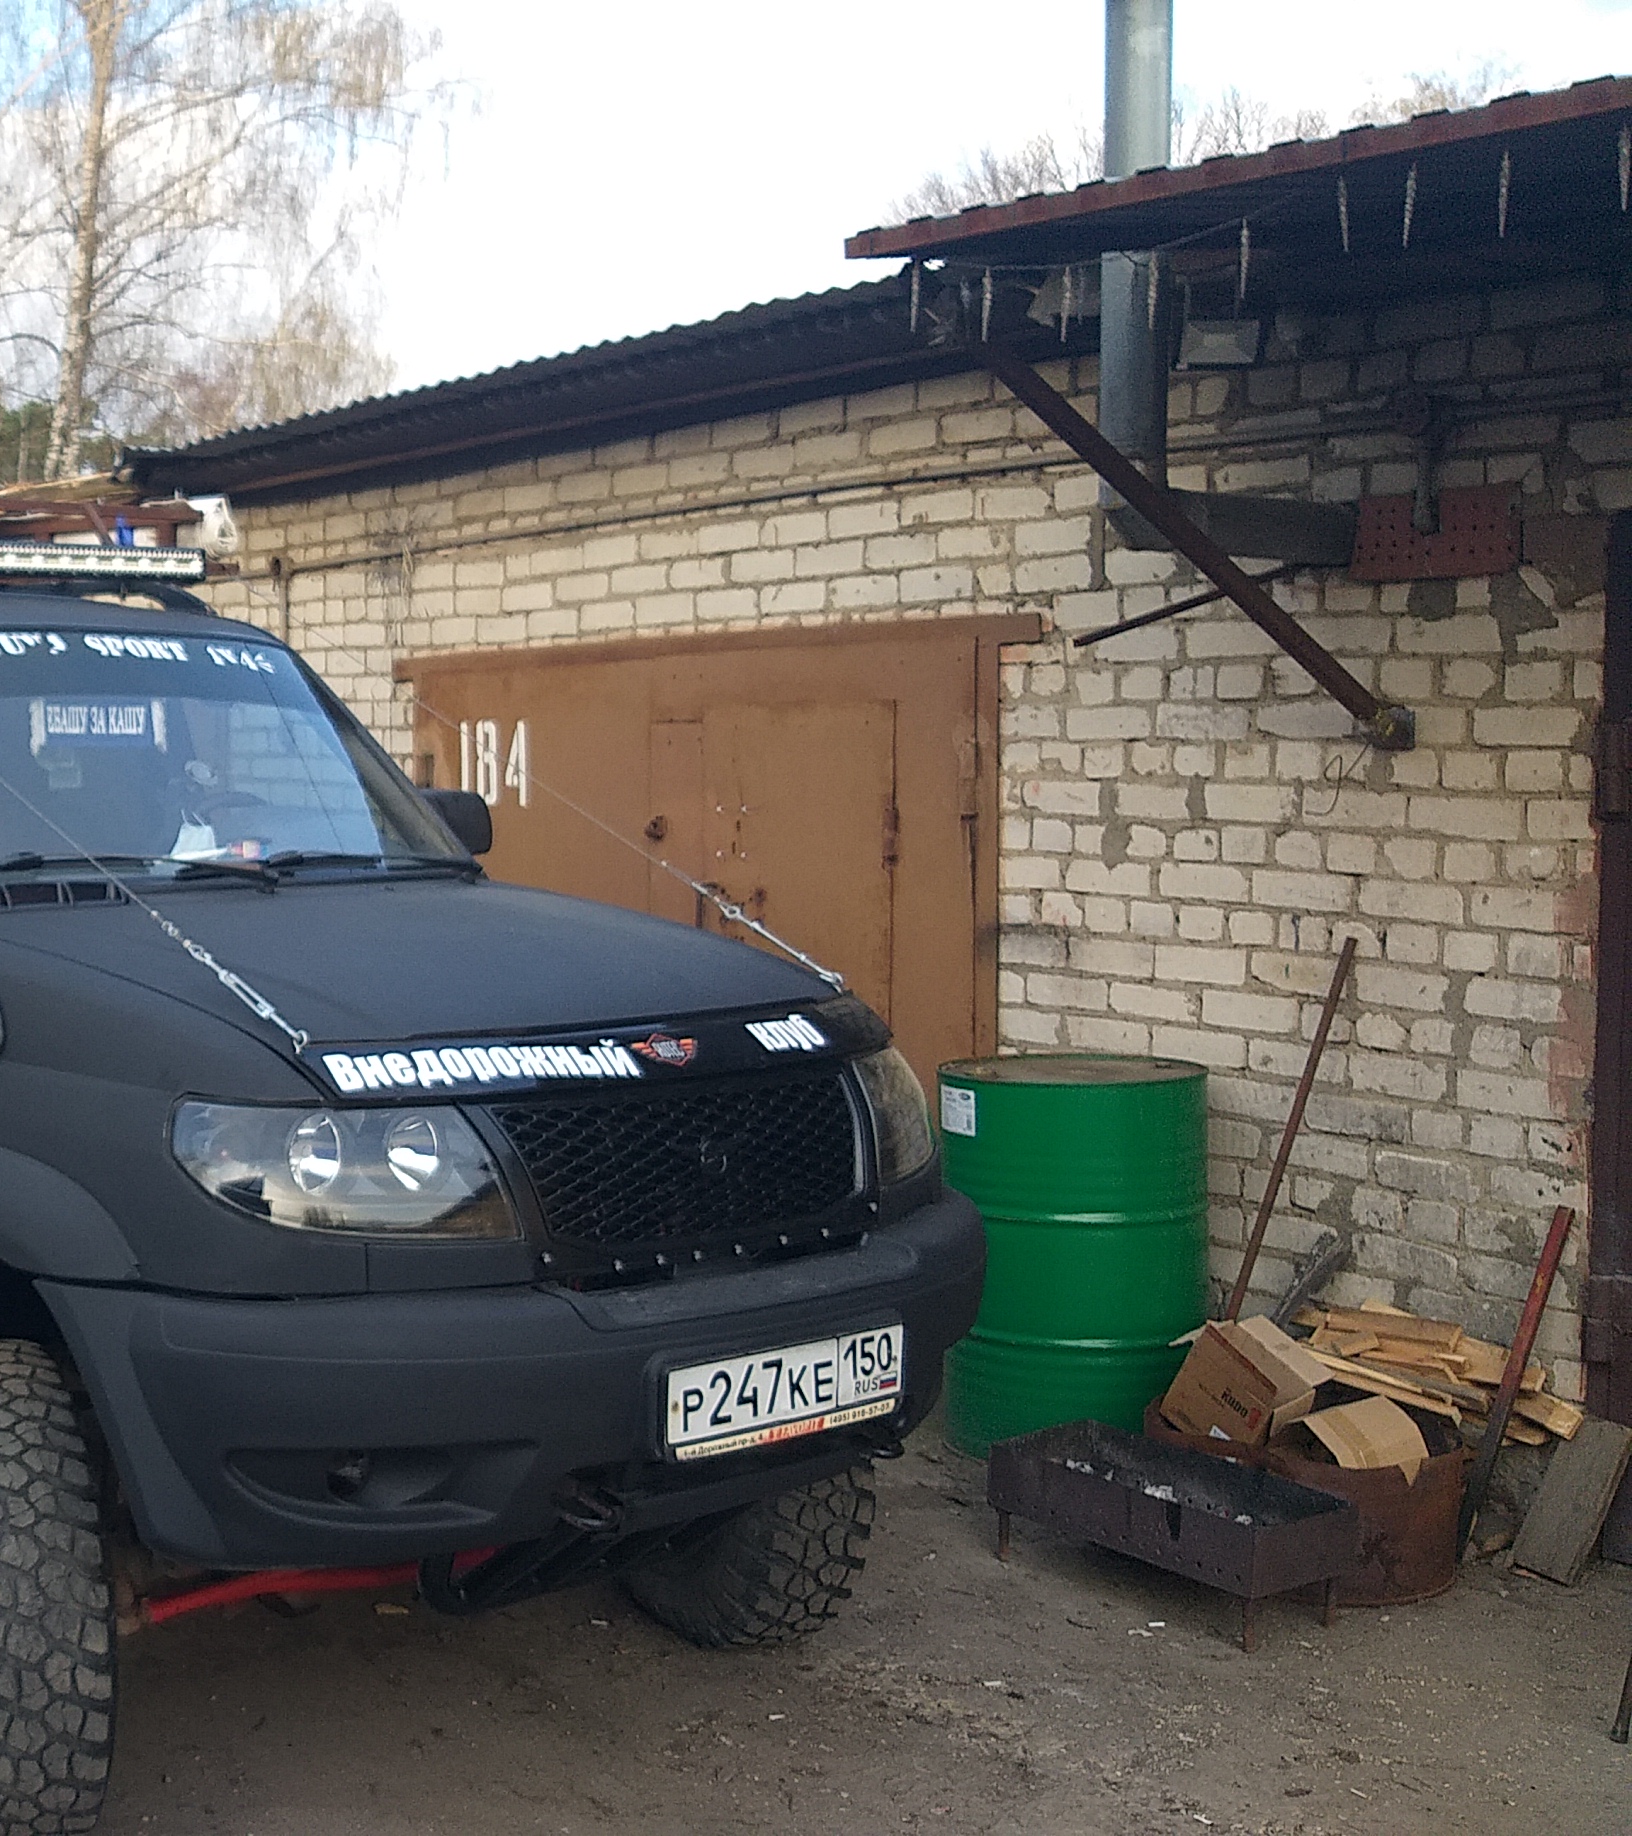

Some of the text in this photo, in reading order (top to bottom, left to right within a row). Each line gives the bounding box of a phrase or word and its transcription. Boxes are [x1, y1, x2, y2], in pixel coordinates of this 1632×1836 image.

[89, 705, 107, 734] ЗА
[108, 705, 145, 734] КАШУ
[459, 719, 527, 807] 184
[322, 1038, 642, 1092] Внедорожный
[843, 1331, 894, 1380] 150
[854, 1376, 879, 1396] RUS
